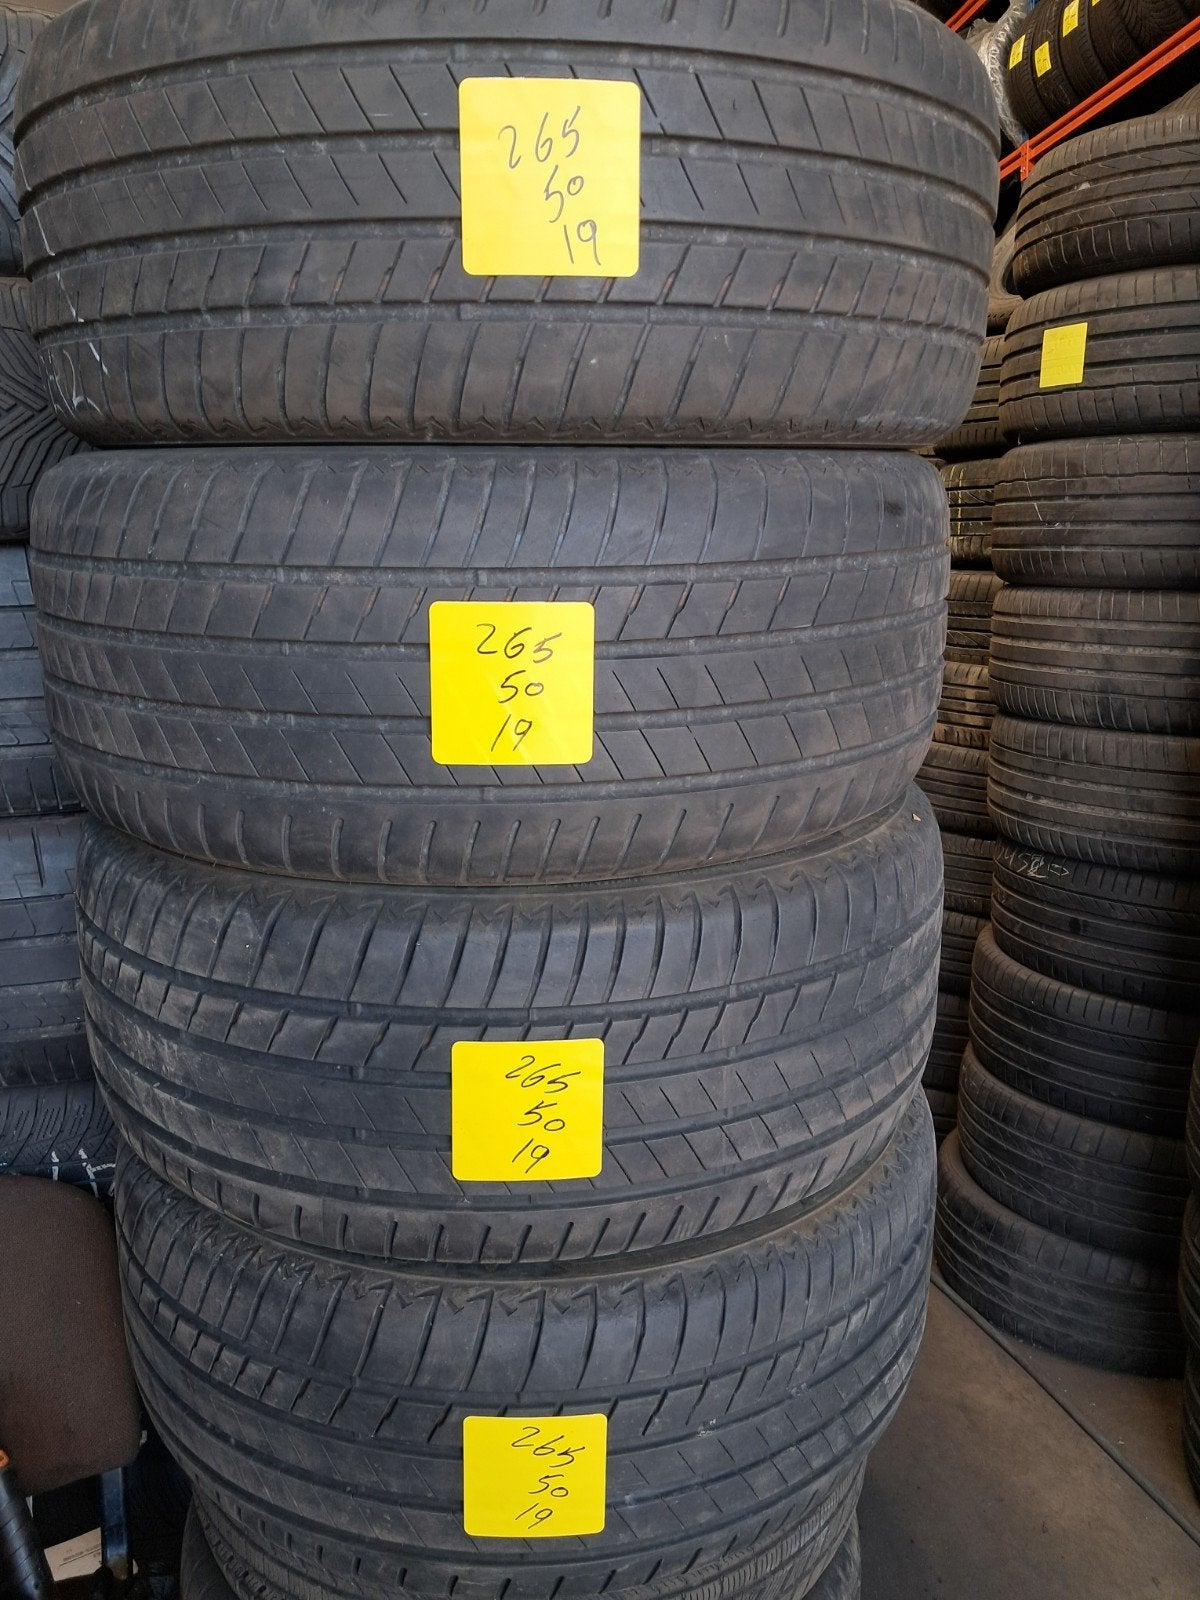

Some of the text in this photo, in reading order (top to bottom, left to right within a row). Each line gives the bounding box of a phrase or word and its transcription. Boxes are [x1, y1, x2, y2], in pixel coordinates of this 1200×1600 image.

[498, 105, 581, 169] 265
[543, 164, 585, 224] 50
[563, 219, 602, 266] 19
[476, 623, 563, 664] 265
[498, 669, 545, 704] 50
[490, 713, 533, 753] 19
[505, 1055, 582, 1094] 265
[517, 1100, 566, 1132] 50
[511, 1138, 551, 1174] 19
[511, 1426, 586, 1468] 265
[528, 1474, 569, 1498] 50
[514, 1502, 554, 1530] 19
